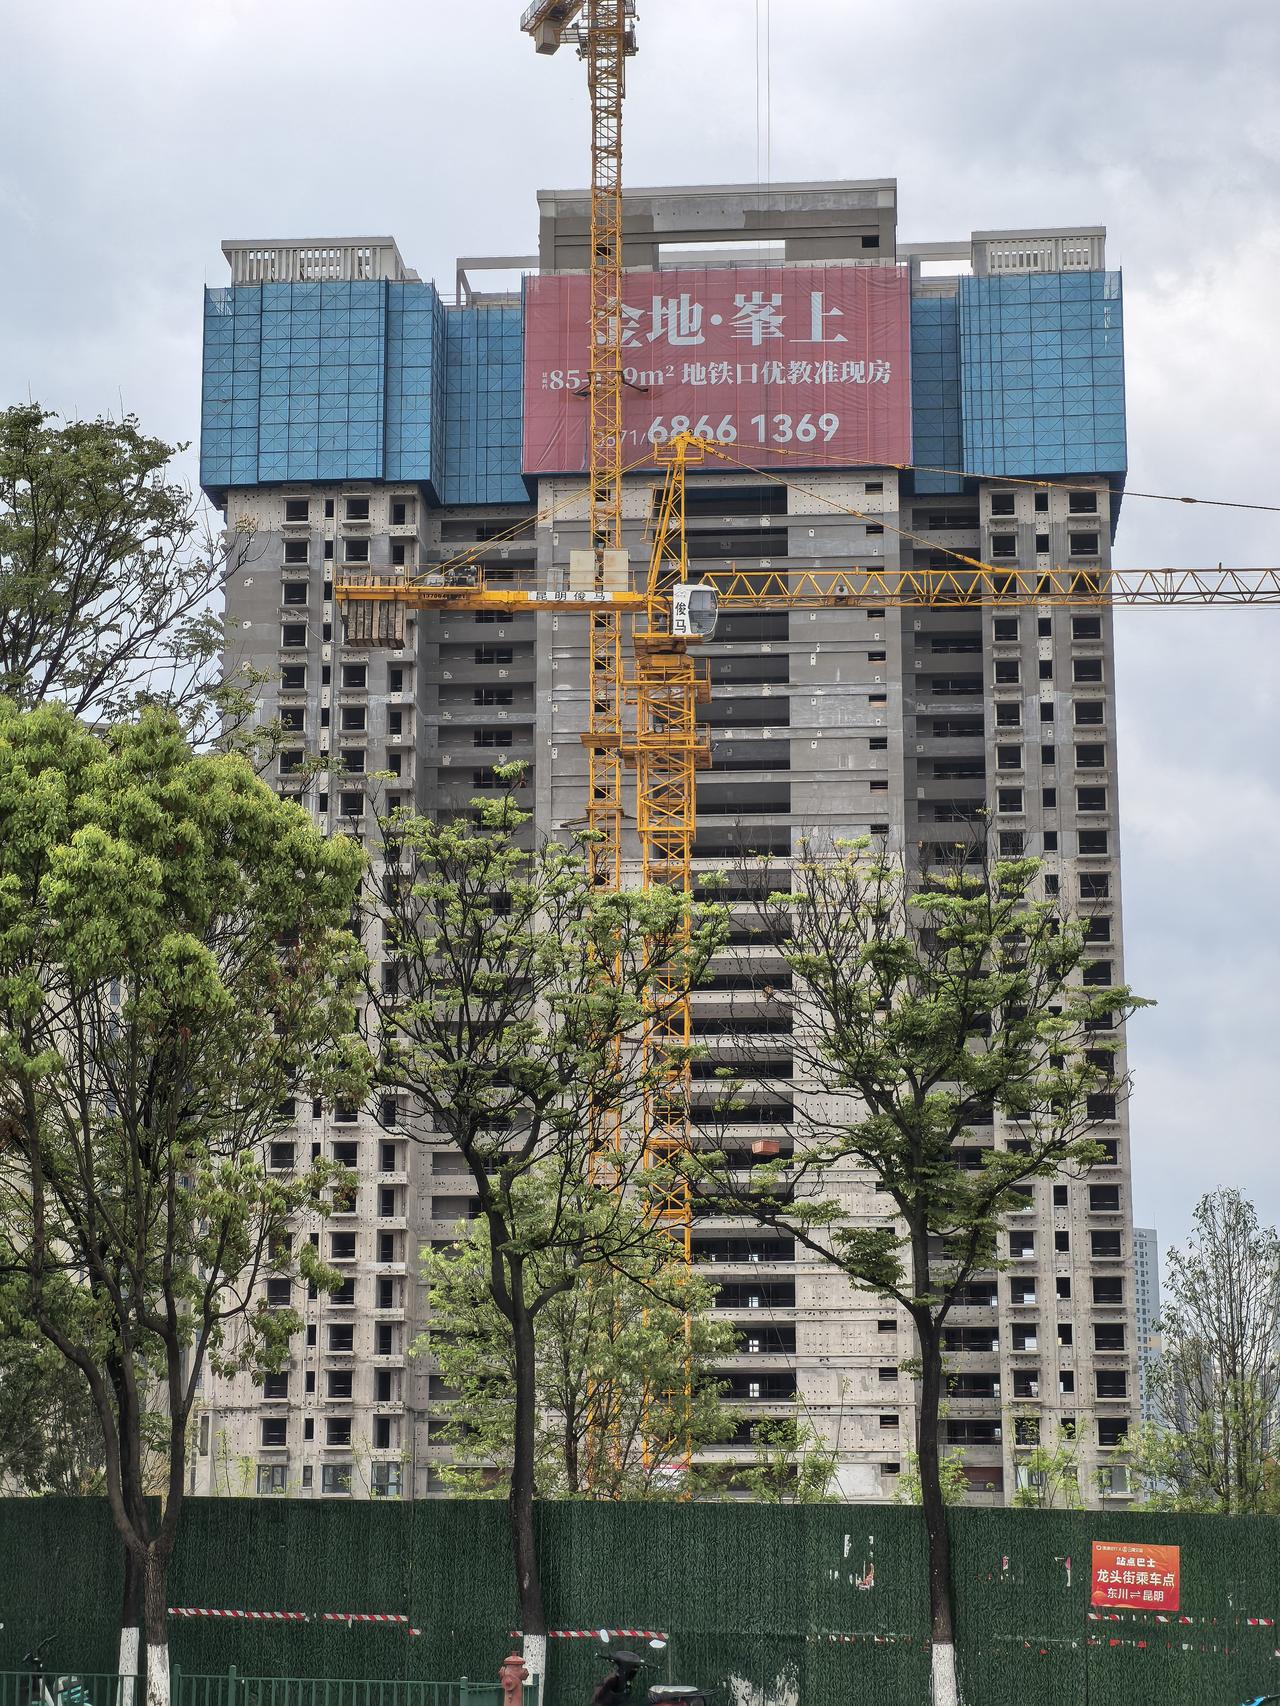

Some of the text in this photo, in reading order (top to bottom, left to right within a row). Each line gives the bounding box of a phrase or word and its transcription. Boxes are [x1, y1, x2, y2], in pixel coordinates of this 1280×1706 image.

[681, 360, 891, 385] 地铁口优教准现房
[751, 413, 840, 443] 1369
[675, 601, 687, 634] 俊马
[1116, 1557, 1156, 1568] 站点巴士
[1097, 1569, 1175, 1587] 龙头街乘车点
[1107, 1588, 1164, 1602] 东川 昆明
